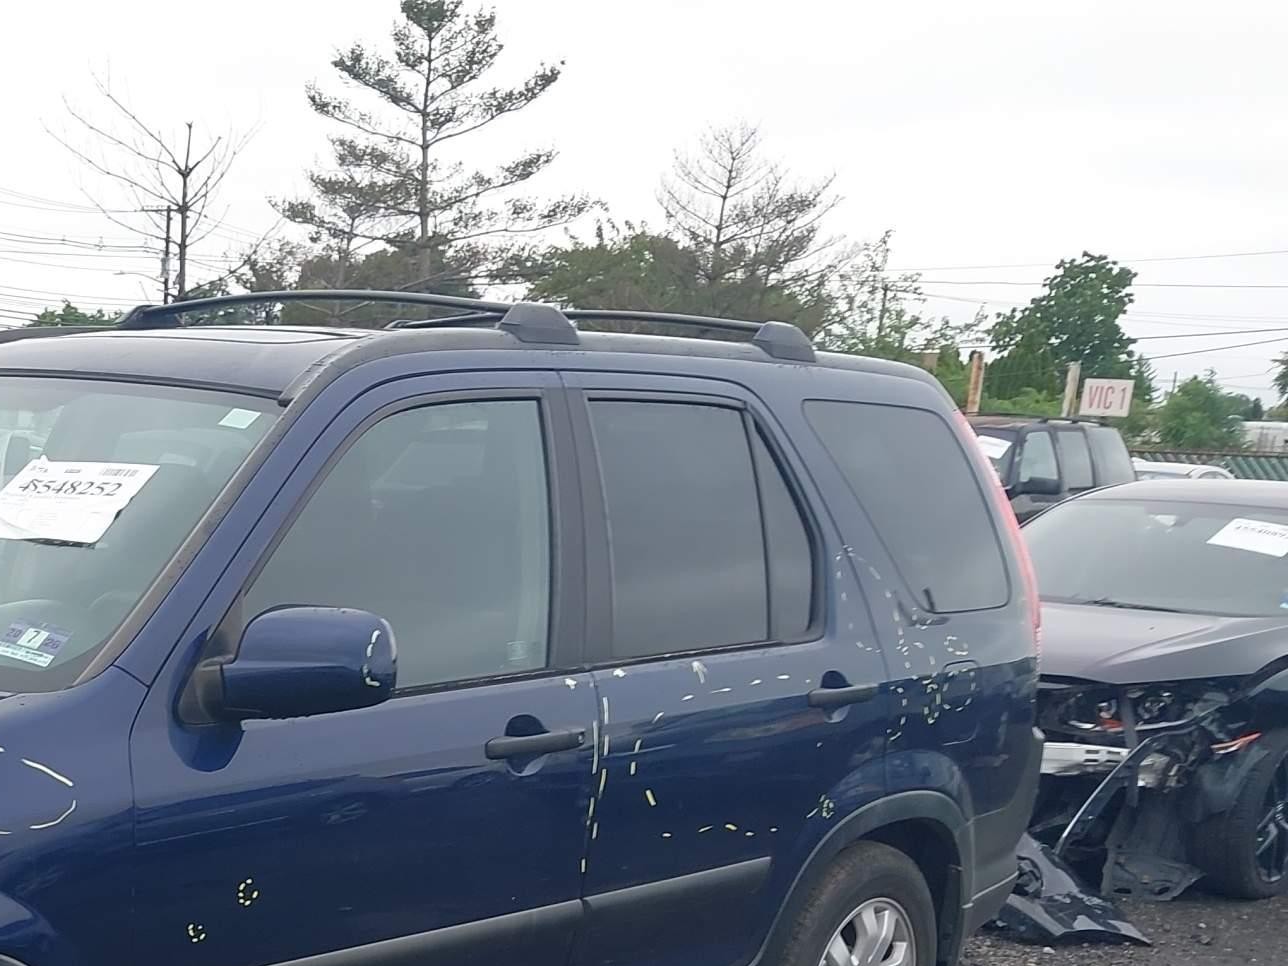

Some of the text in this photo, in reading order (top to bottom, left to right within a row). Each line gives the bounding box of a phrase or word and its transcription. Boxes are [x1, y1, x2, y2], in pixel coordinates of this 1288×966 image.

[1088, 385, 1127, 410] VIC 1
[18, 478, 122, 497] 45548252
[27, 630, 41, 643] 7
